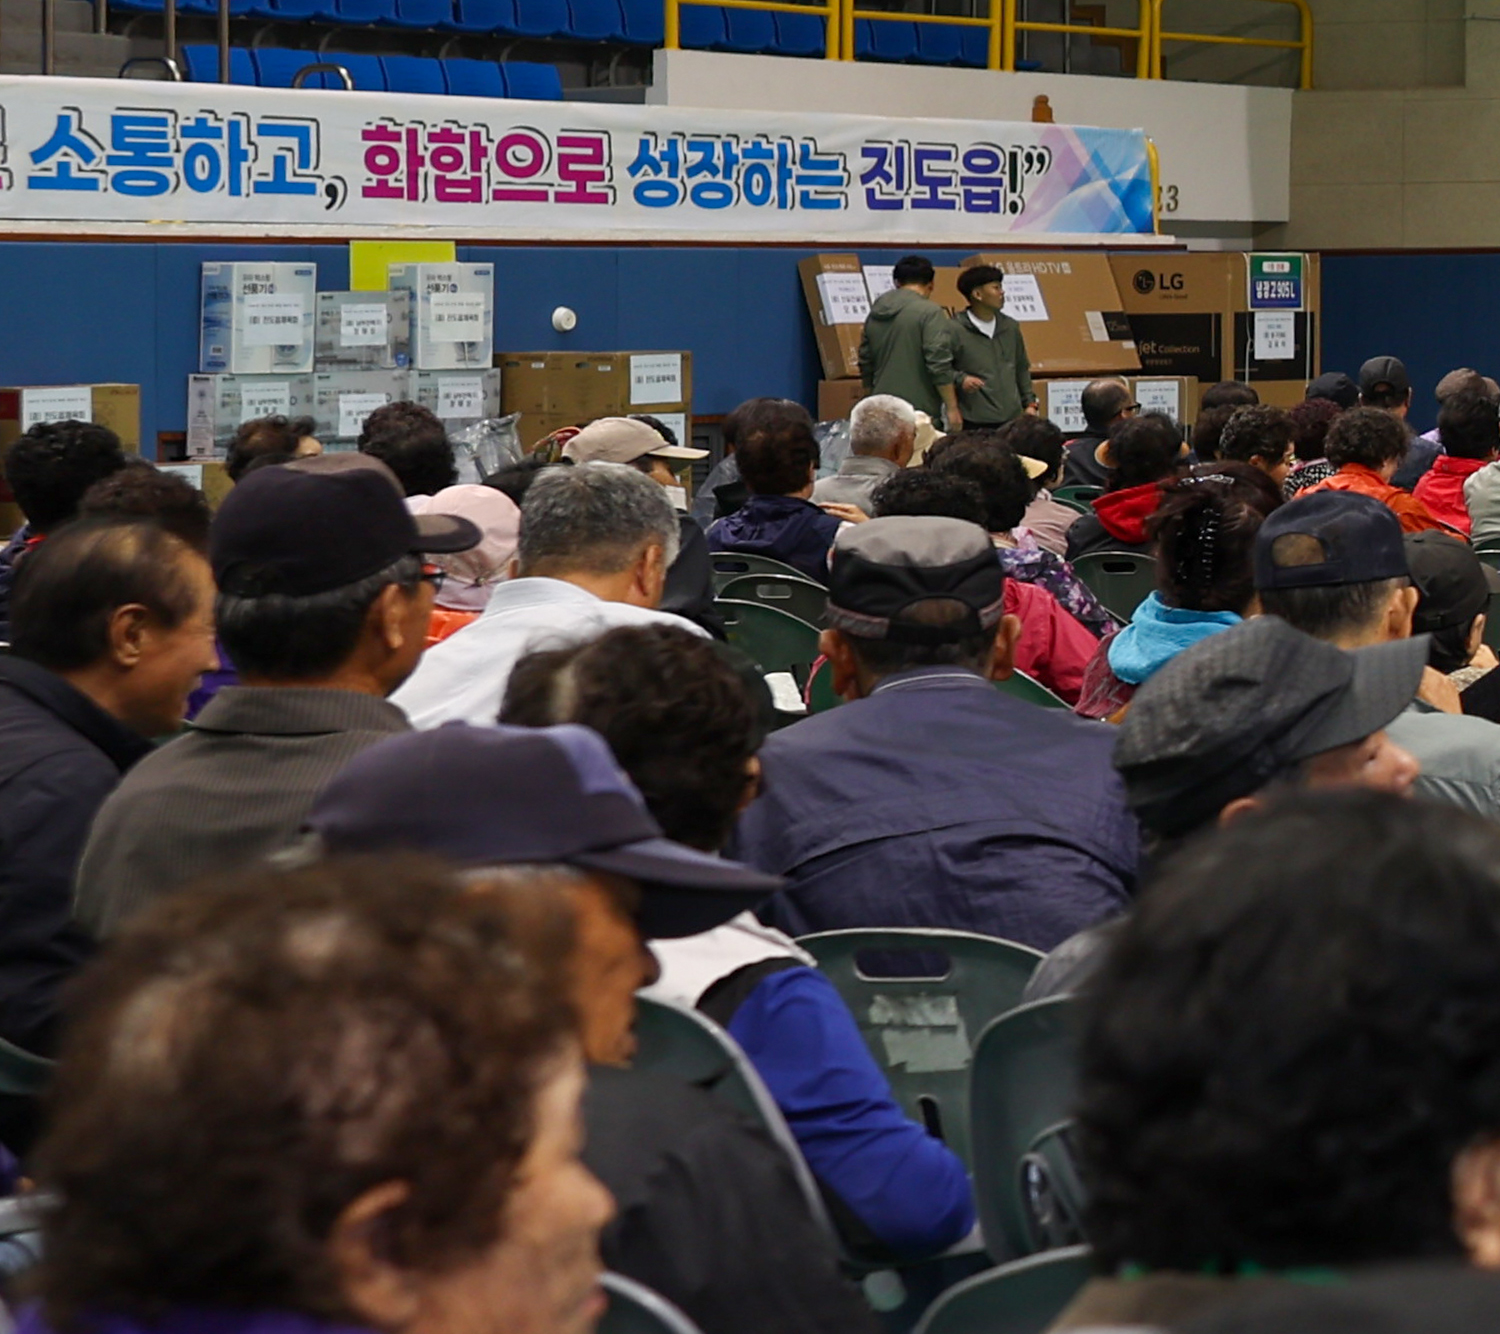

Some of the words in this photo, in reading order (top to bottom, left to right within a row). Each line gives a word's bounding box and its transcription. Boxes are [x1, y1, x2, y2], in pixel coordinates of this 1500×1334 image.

[27, 109, 344, 211] 소통하고,
[361, 120, 613, 204] 화합으로
[627, 133, 846, 210] 성장하는
[1160, 274, 1184, 290] LG
